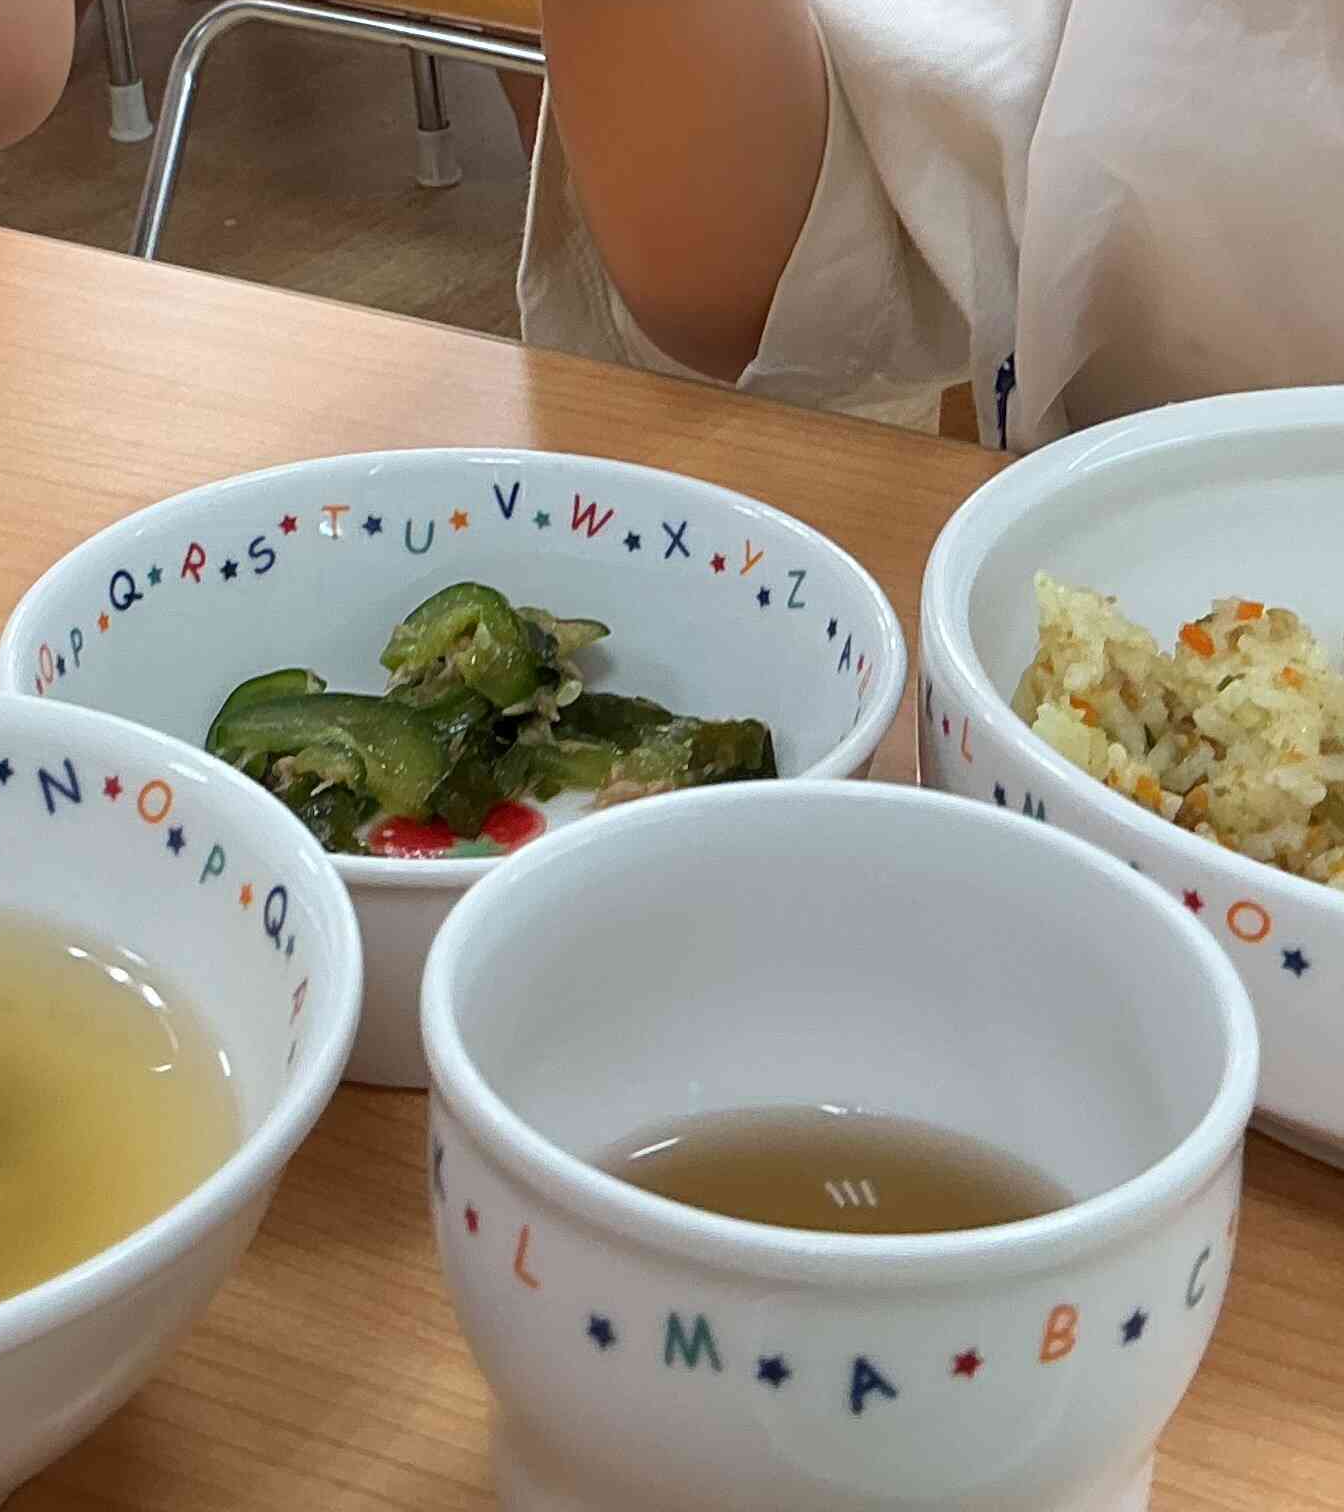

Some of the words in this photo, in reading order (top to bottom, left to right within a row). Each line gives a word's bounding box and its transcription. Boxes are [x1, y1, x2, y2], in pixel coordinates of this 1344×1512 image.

[70, 626, 85, 667] P
[109, 568, 144, 612] Q
[180, 541, 207, 584] R
[248, 535, 277, 575] S
[320, 503, 352, 540] T
[404, 518, 435, 555] U
[492, 481, 521, 520] V
[570, 493, 615, 539] W
[661, 520, 691, 560] X
[786, 569, 808, 609] Z
[837, 633, 853, 674] A
[37, 757, 83, 816] N
[137, 779, 173, 824] O
[199, 844, 226, 885] P
[262, 884, 288, 951] Q
[1226, 900, 1271, 943] O
[512, 1224, 541, 1289] L
[663, 1311, 723, 1374] M
[848, 1354, 899, 1415] A
[1038, 1303, 1081, 1364] B
[1184, 1245, 1211, 1309] C
